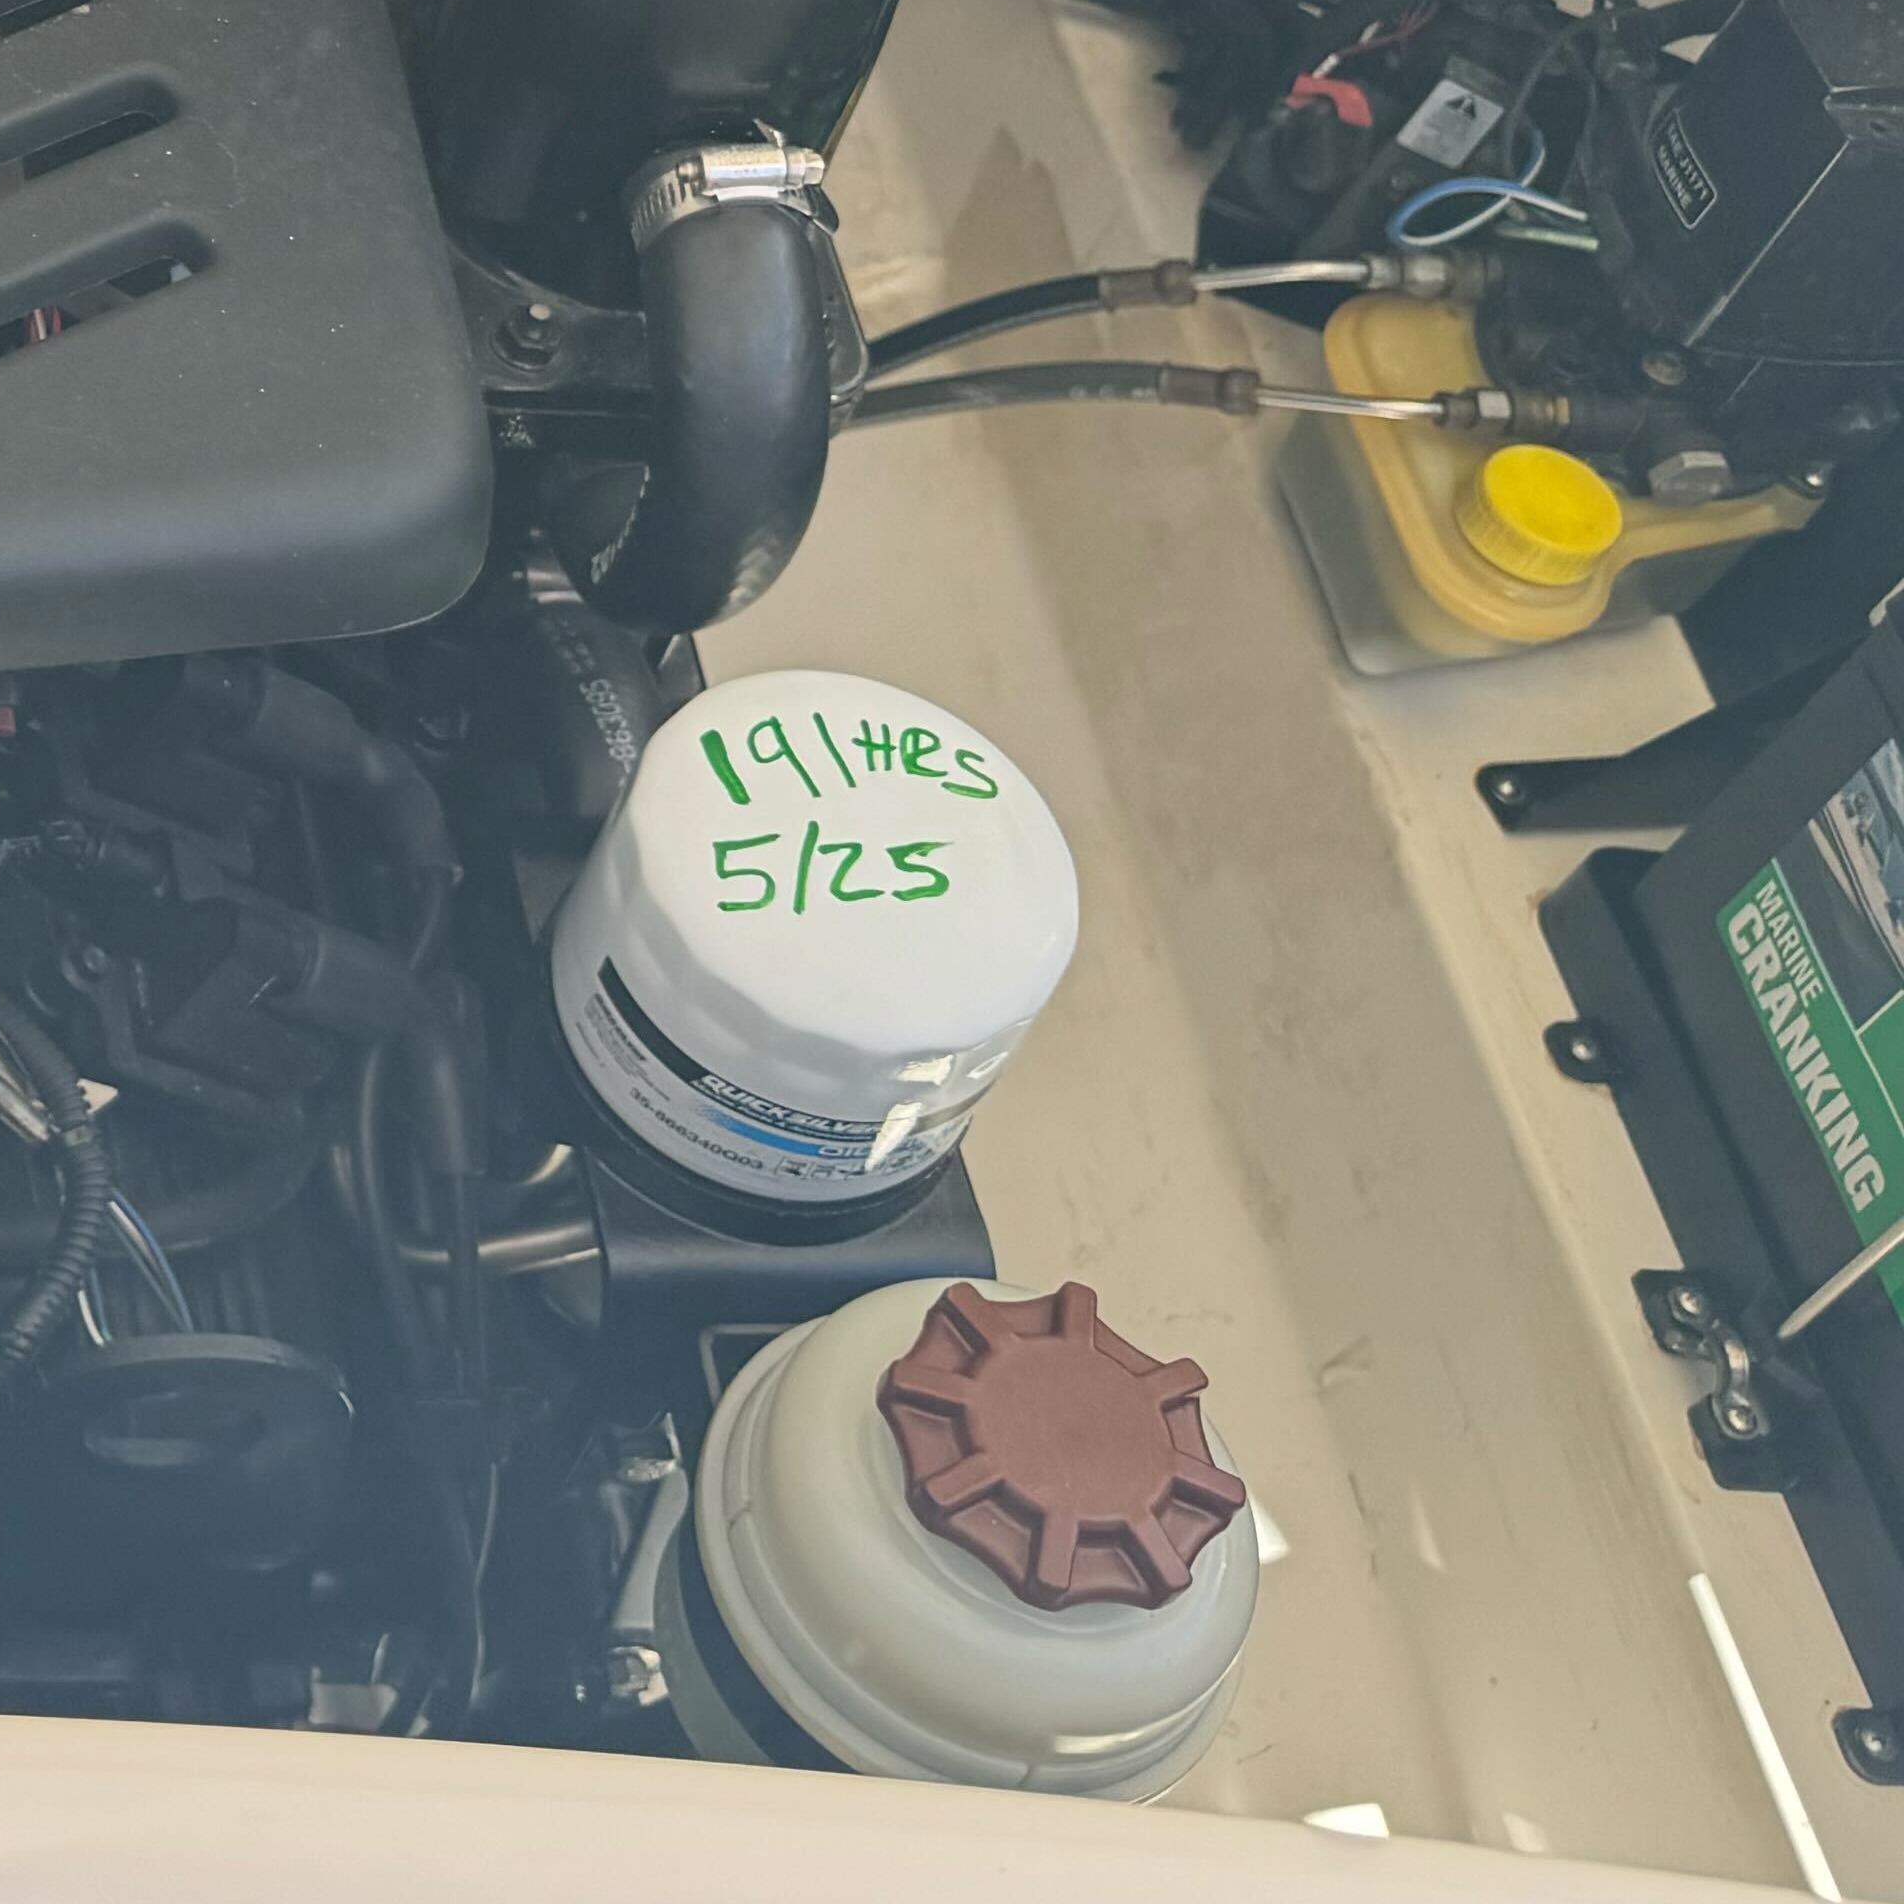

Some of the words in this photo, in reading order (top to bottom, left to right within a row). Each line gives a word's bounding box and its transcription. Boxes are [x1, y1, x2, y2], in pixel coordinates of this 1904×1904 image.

[712, 819, 955, 916] 5/25
[1755, 878, 1824, 1009] MARINE
[698, 1073, 882, 1135] QUICKSILVE
[1728, 901, 1886, 1213] CRANKING
